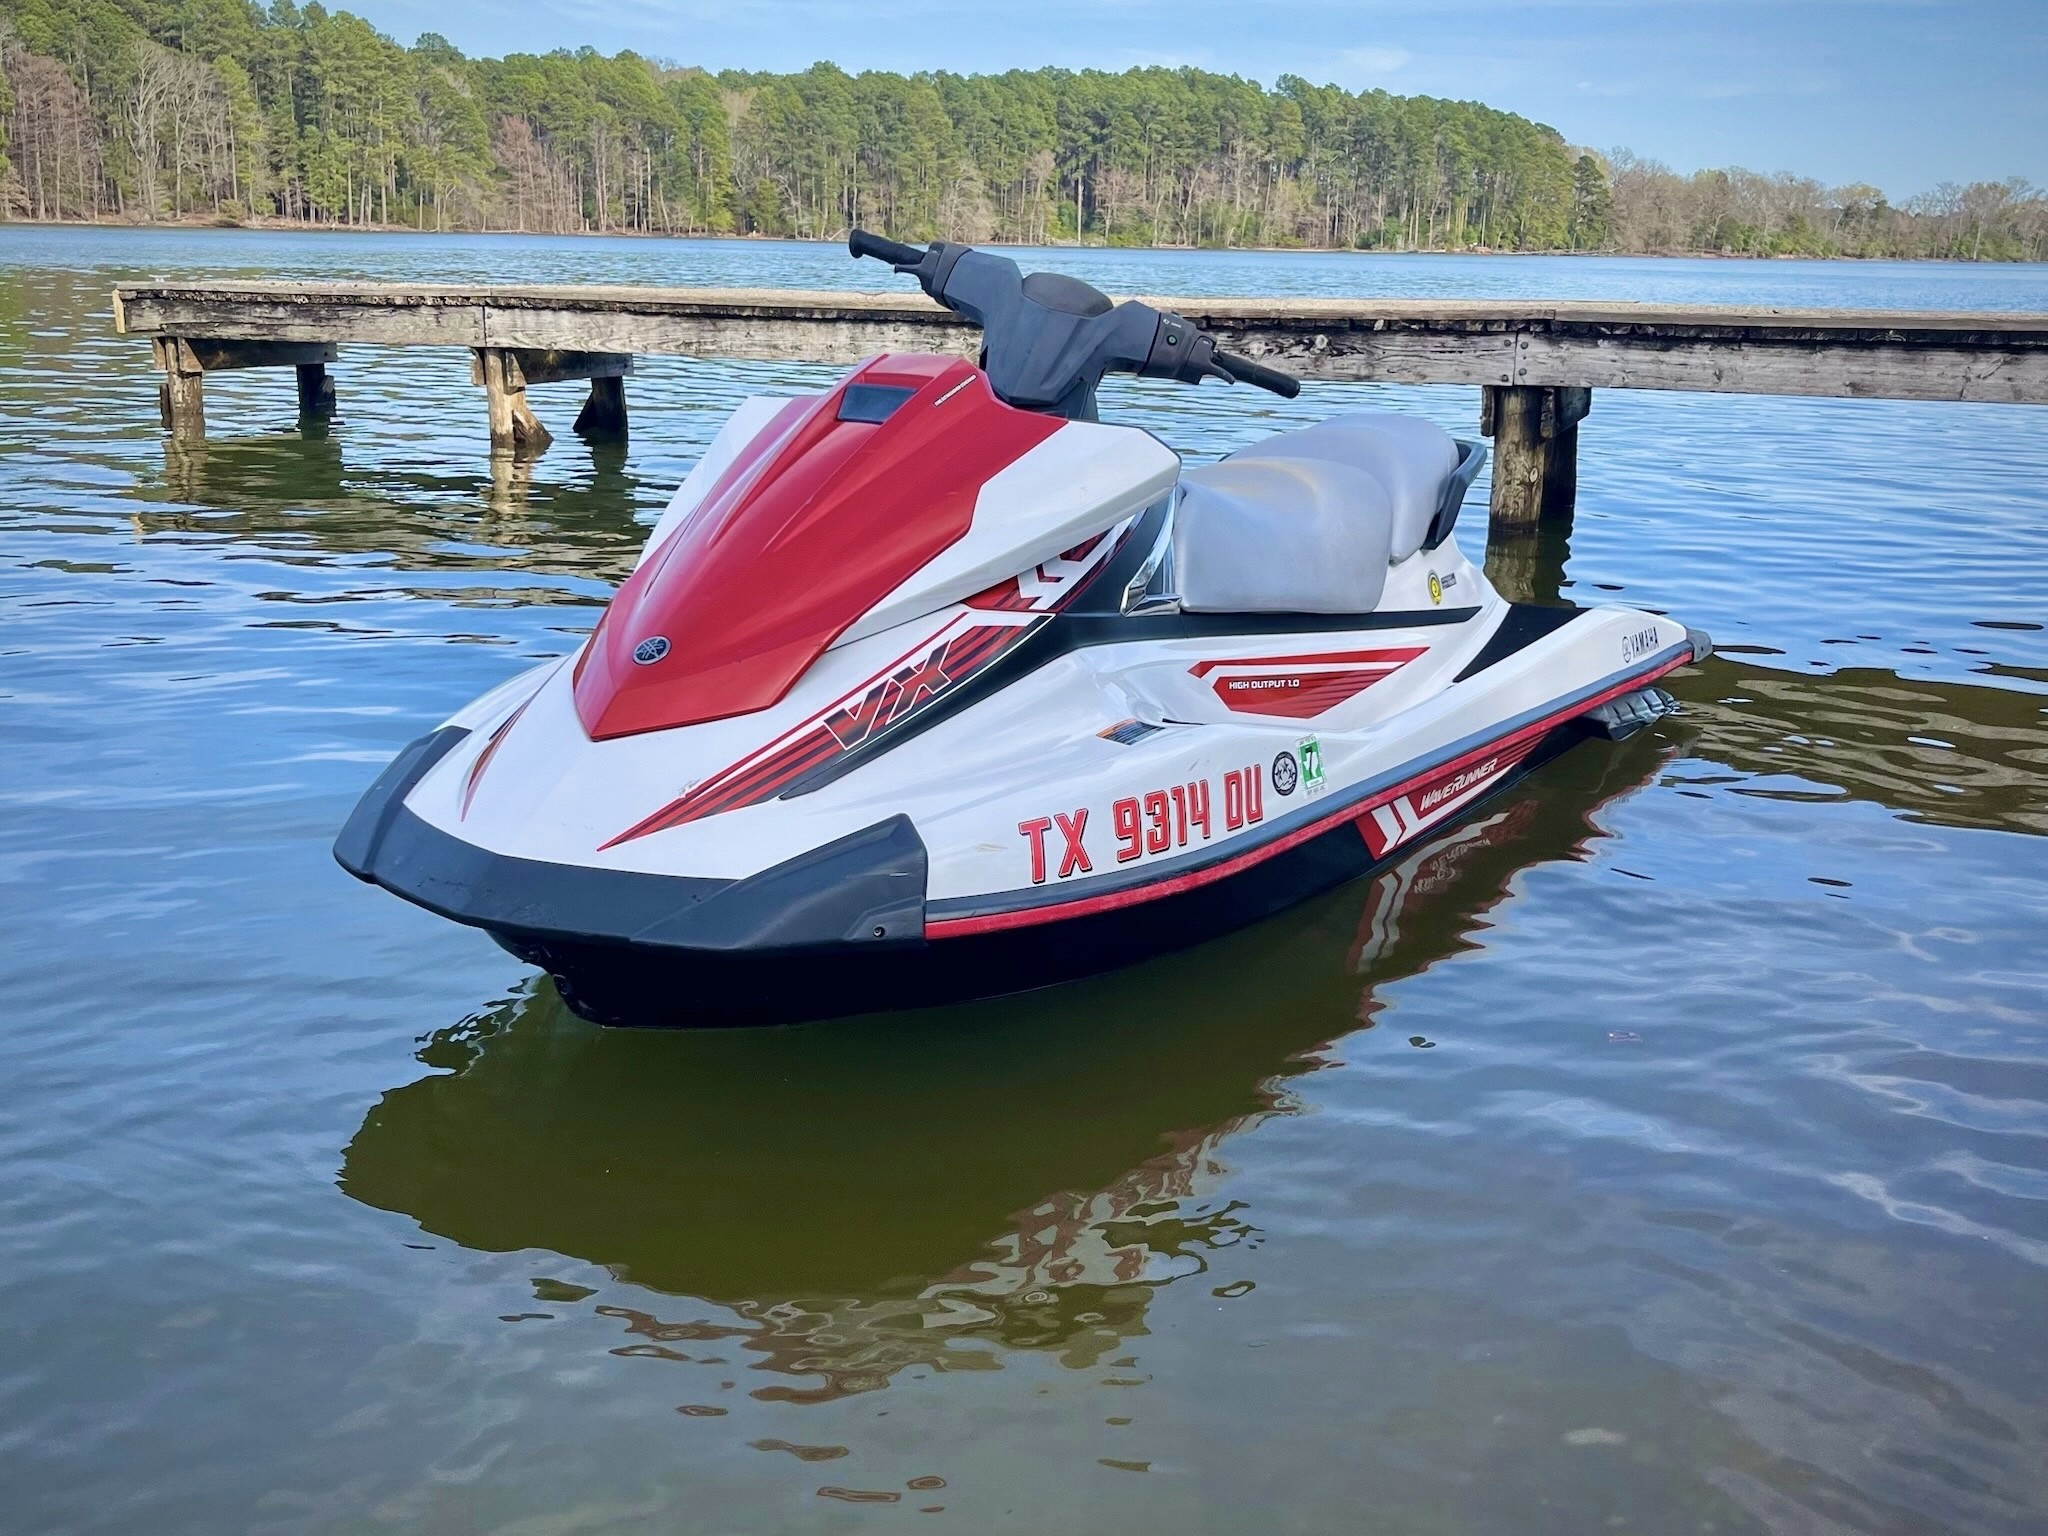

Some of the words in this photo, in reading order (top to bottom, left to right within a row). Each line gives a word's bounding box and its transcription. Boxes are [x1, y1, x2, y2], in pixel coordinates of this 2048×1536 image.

[1630, 626, 1660, 658] YAMAHA
[823, 639, 953, 751] VX
[1229, 681, 1250, 690] HIGH
[1251, 680, 1286, 689] OUTPUT
[1287, 679, 1300, 688] 1.0
[1018, 808, 1092, 884] TX
[1113, 779, 1210, 863] 9314
